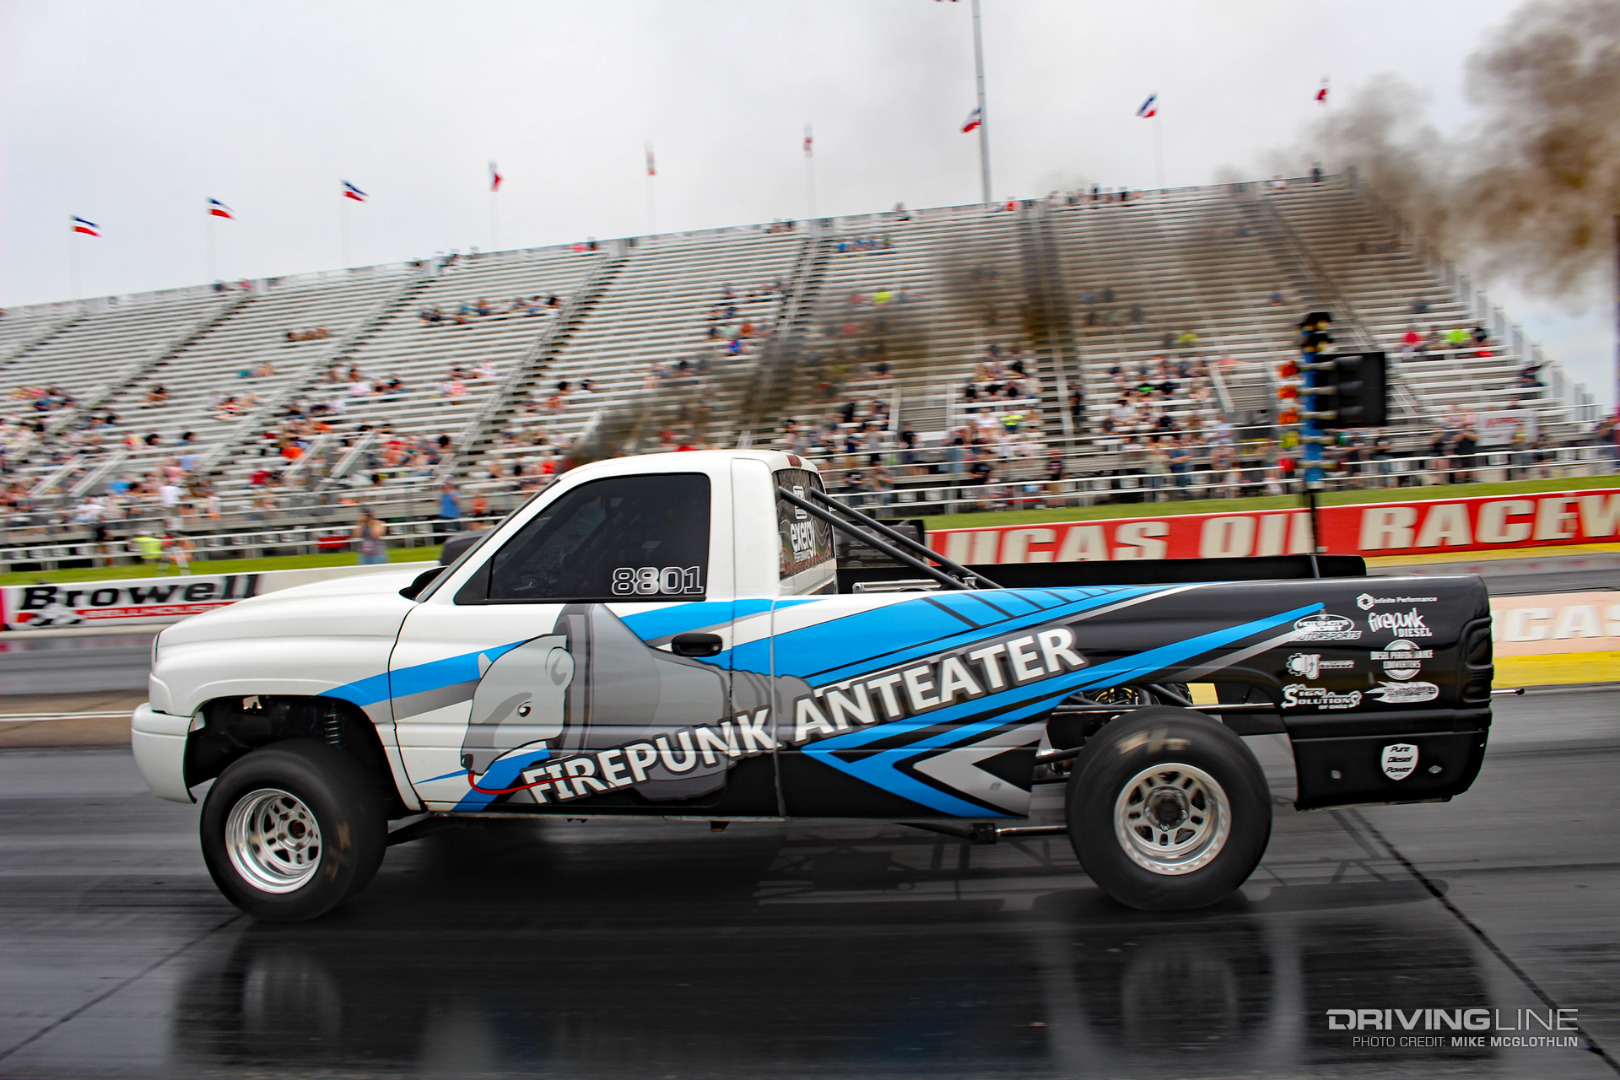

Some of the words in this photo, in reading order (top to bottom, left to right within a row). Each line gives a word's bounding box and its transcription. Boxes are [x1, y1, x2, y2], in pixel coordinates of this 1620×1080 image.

[925, 521, 1169, 565] UCAS
[1201, 512, 1328, 558] OIL
[20, 574, 262, 610] Browell
[611, 566, 704, 595] 8801
[1398, 628, 1432, 637] DIESEL
[1491, 604, 1620, 642] CA
[522, 708, 780, 803] FIREPUNK
[795, 628, 1086, 743] ANTEATER
